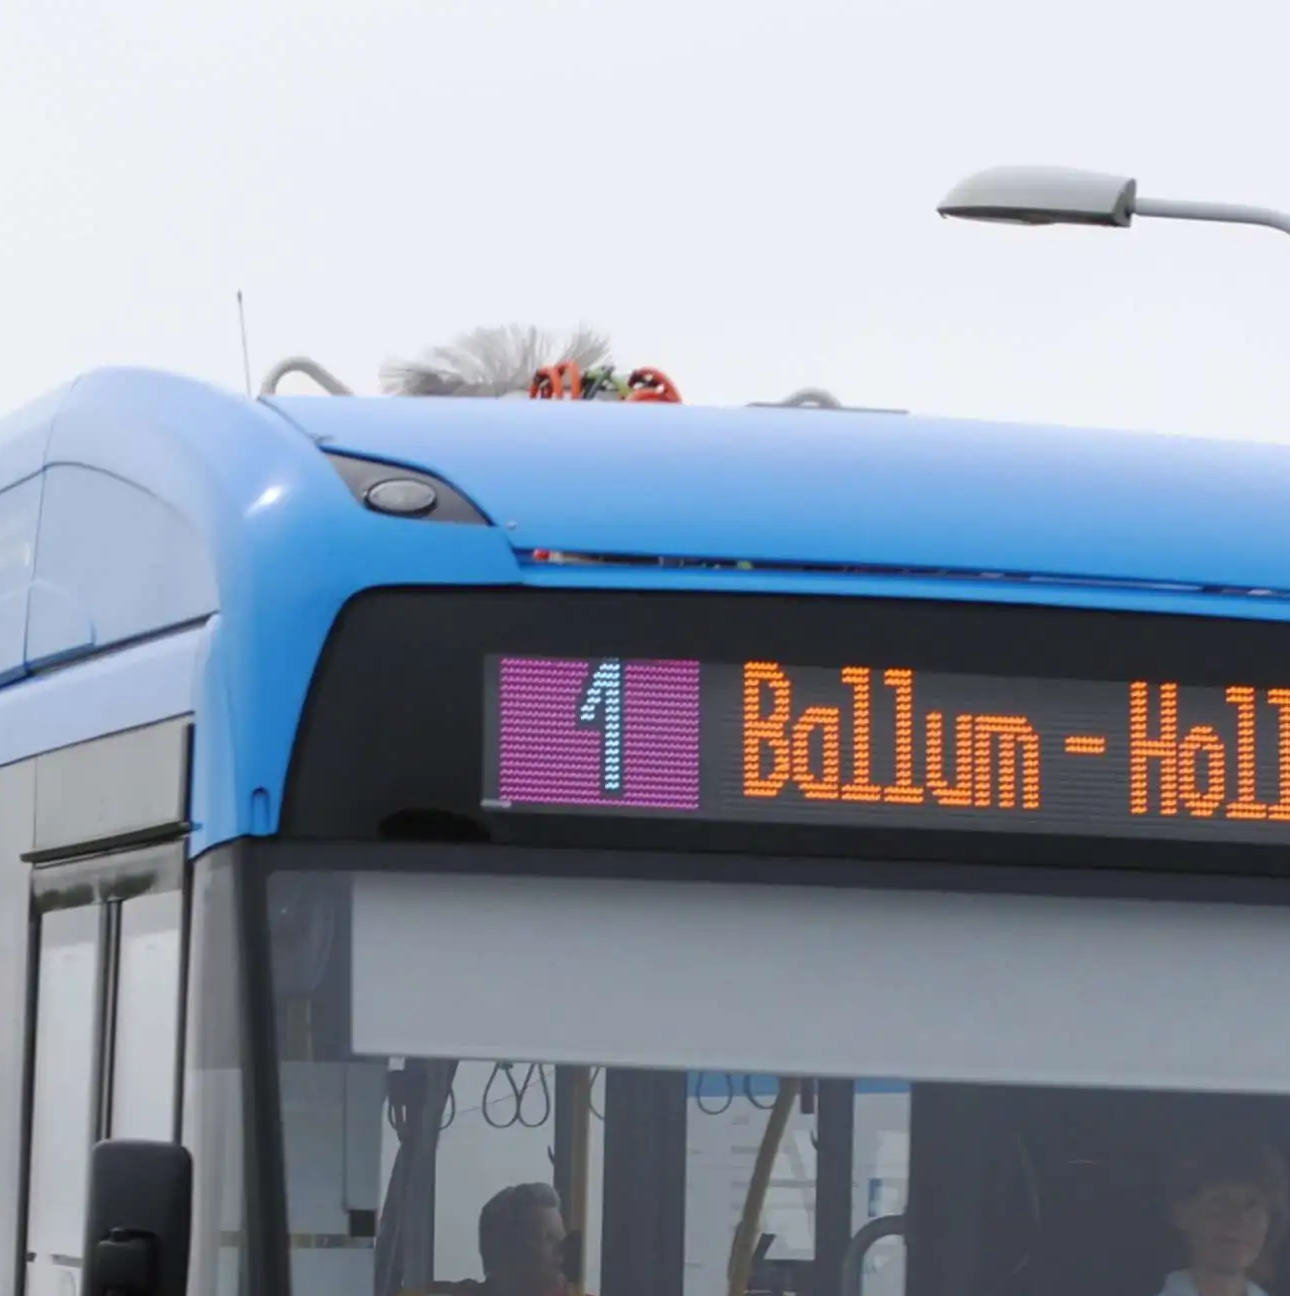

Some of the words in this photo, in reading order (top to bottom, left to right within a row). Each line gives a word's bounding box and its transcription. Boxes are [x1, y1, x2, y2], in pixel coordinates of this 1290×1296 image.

[581, 659, 621, 791] 1
[743, 660, 1040, 810] Ballum
[1064, 735, 1106, 755] -
